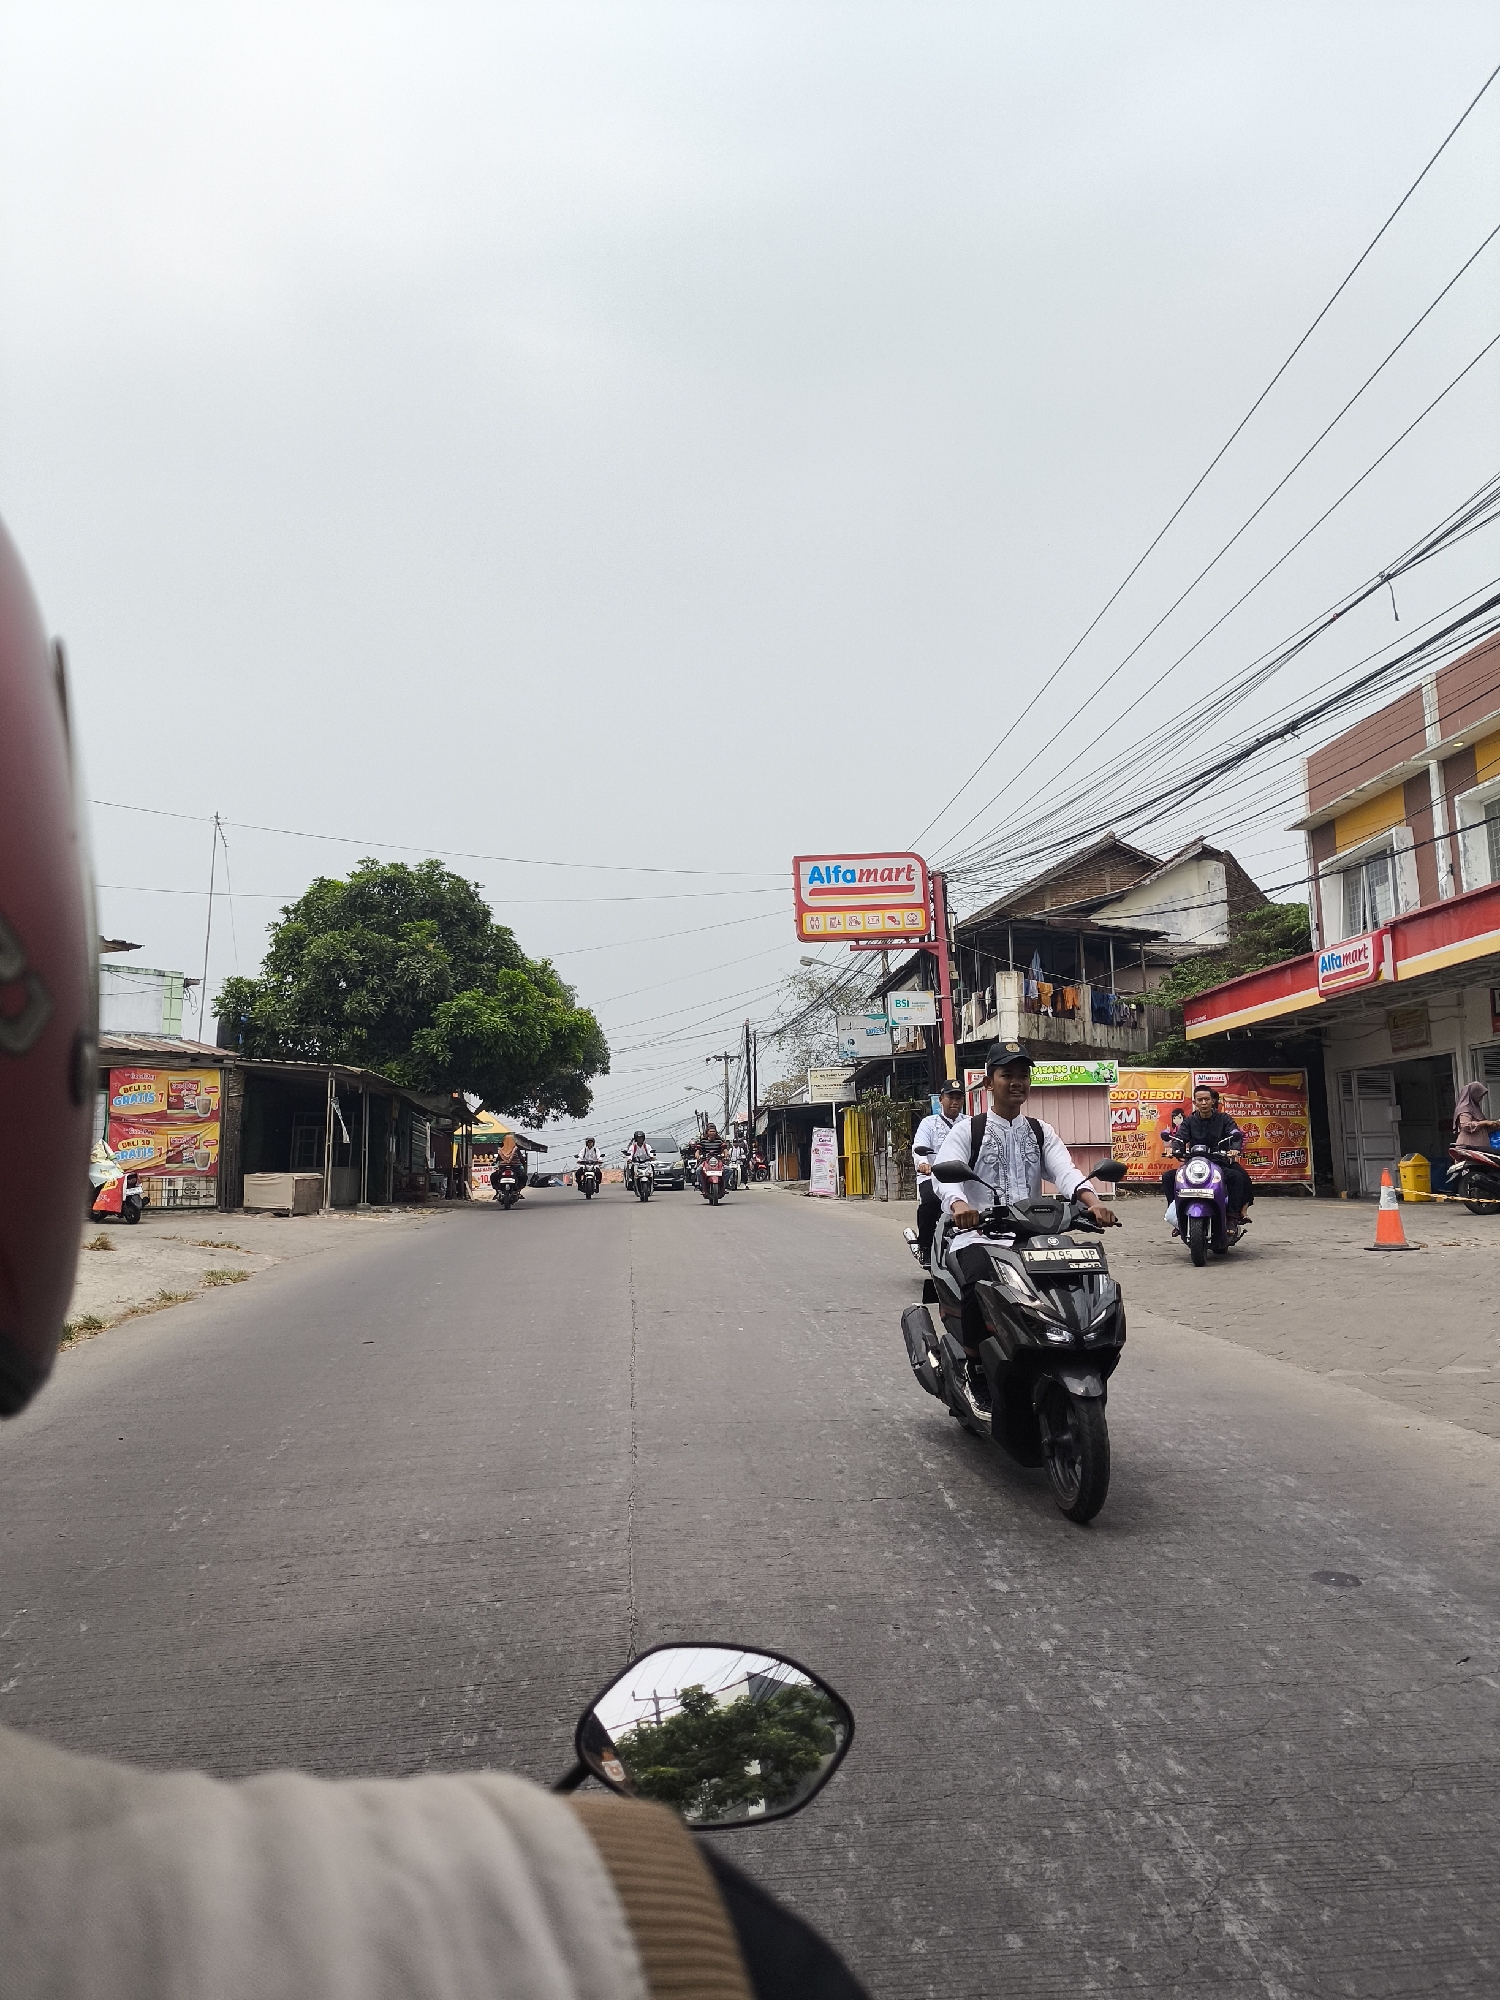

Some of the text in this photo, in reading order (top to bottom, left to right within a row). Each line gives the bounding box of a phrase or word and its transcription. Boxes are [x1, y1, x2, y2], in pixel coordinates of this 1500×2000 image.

[808, 864, 915, 884] Alfamart
[1320, 943, 1369, 973] Alfamart
[1032, 1065, 1068, 1075] PISANG
[123, 1083, 140, 1093] BELI
[113, 1092, 155, 1106] GRATIS
[1140, 1091, 1183, 1100] HEBOH
[1027, 1251, 1035, 1261] A
